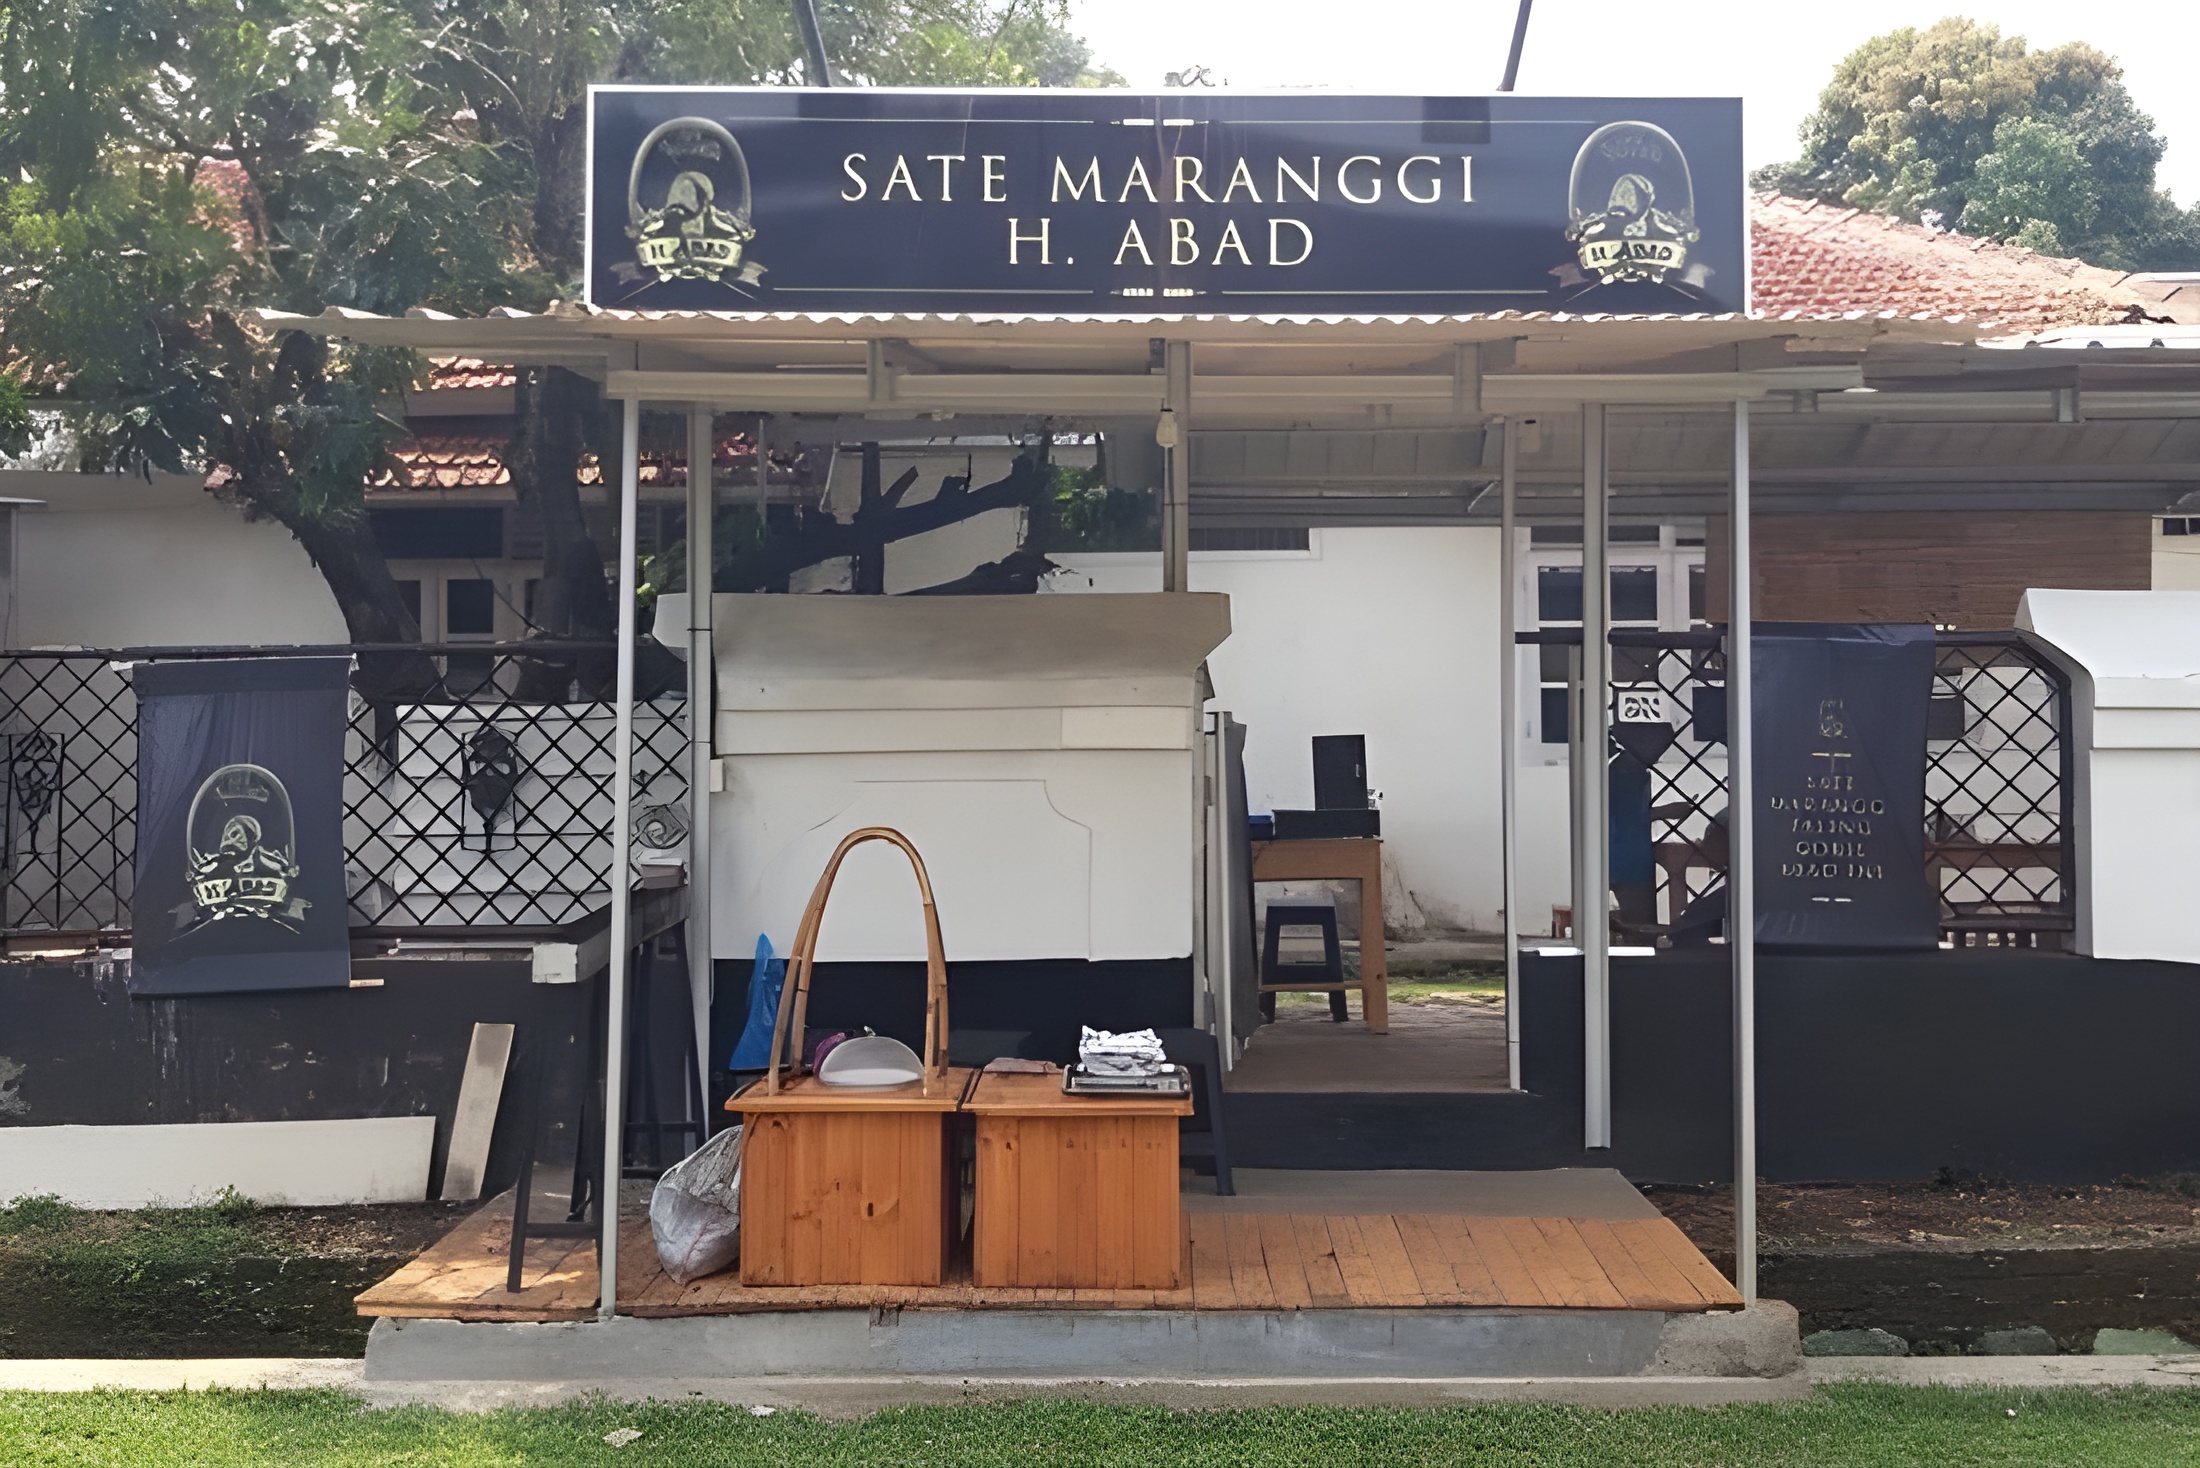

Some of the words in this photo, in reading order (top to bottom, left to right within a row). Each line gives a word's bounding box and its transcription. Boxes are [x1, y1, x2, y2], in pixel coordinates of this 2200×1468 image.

[840, 152, 1007, 203] SATE
[1050, 154, 1476, 205] MARANGGI
[1008, 217, 1075, 266] H.
[1112, 218, 1315, 267] ABAD
